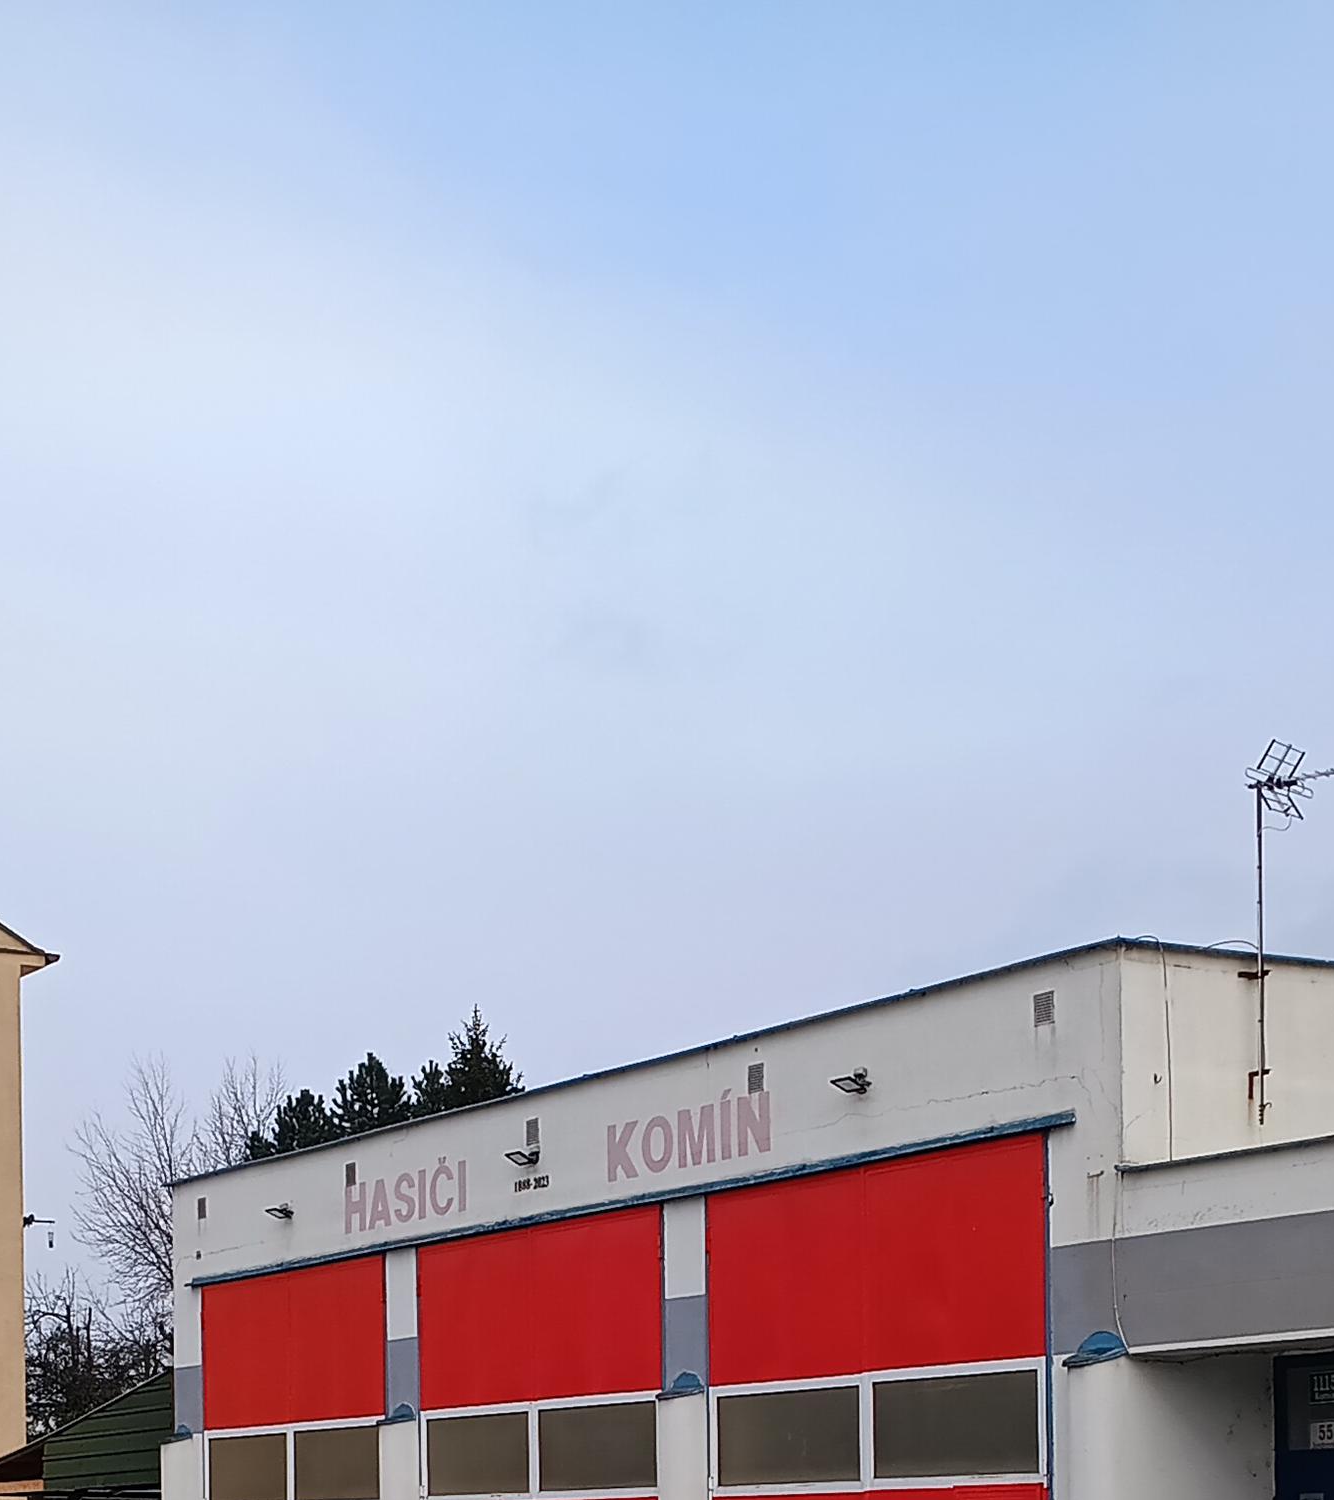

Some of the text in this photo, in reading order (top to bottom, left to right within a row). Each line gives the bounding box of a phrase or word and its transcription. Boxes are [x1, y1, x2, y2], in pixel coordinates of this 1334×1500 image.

[345, 1088, 772, 1235] HASIČI KOMÍN
[1319, 1423, 1334, 1441] 55
